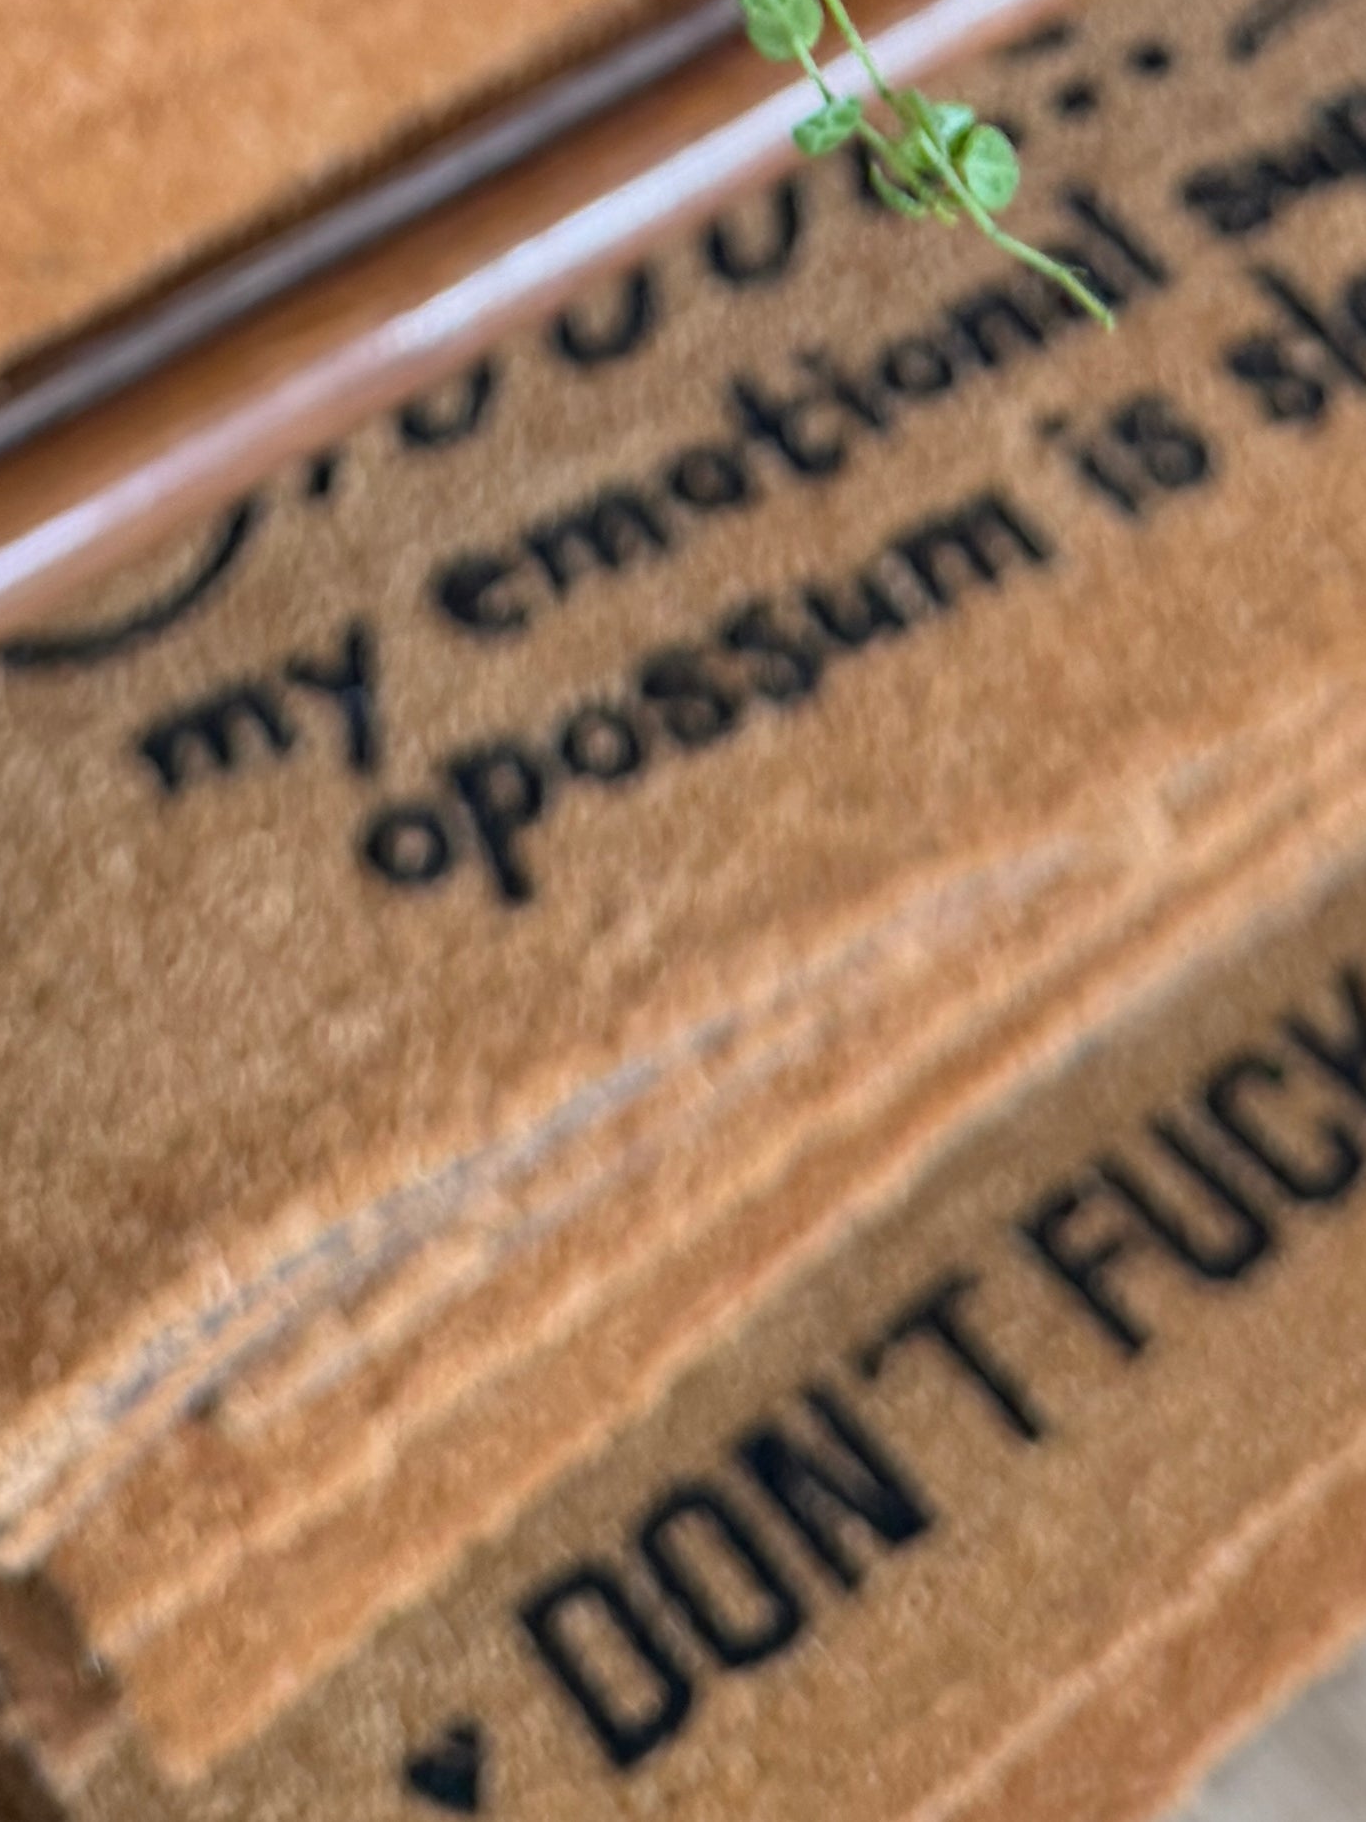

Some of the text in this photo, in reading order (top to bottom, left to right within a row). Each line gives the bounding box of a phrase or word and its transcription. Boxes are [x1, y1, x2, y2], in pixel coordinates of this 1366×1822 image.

[138, 622, 381, 796] my
[433, 186, 1167, 636] emotional
[361, 488, 1051, 901] opossum
[1038, 392, 1215, 516] is
[518, 1274, 1043, 1769] DON'T
